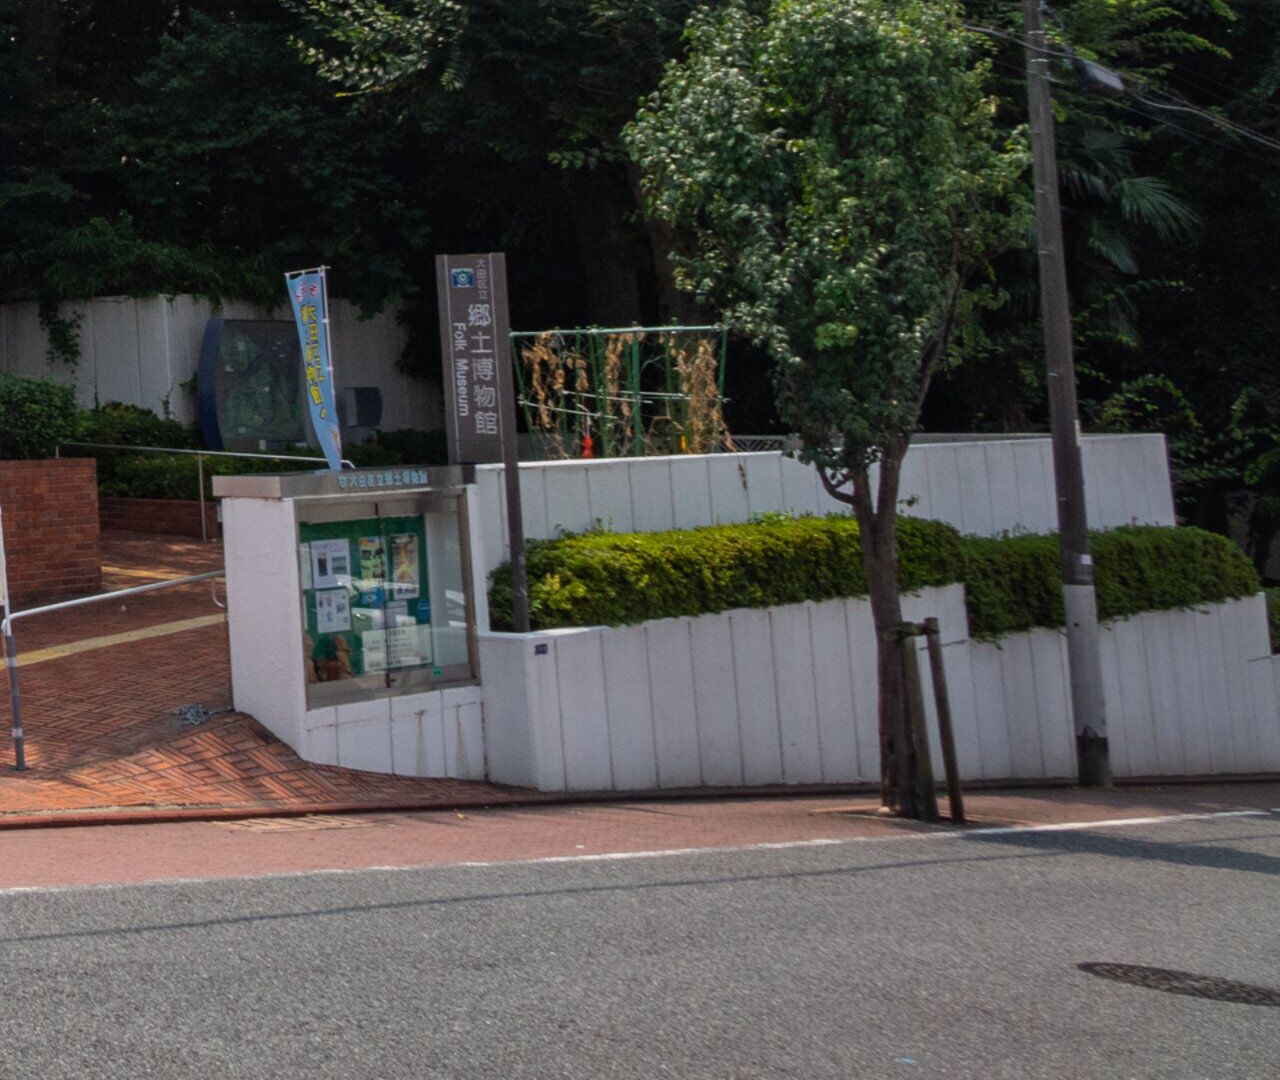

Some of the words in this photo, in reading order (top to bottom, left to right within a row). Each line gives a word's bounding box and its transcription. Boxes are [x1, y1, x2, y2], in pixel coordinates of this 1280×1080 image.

[453, 322, 468, 352] Folk
[455, 358, 469, 417] Museum
[468, 303, 498, 435] 郷土博物館
